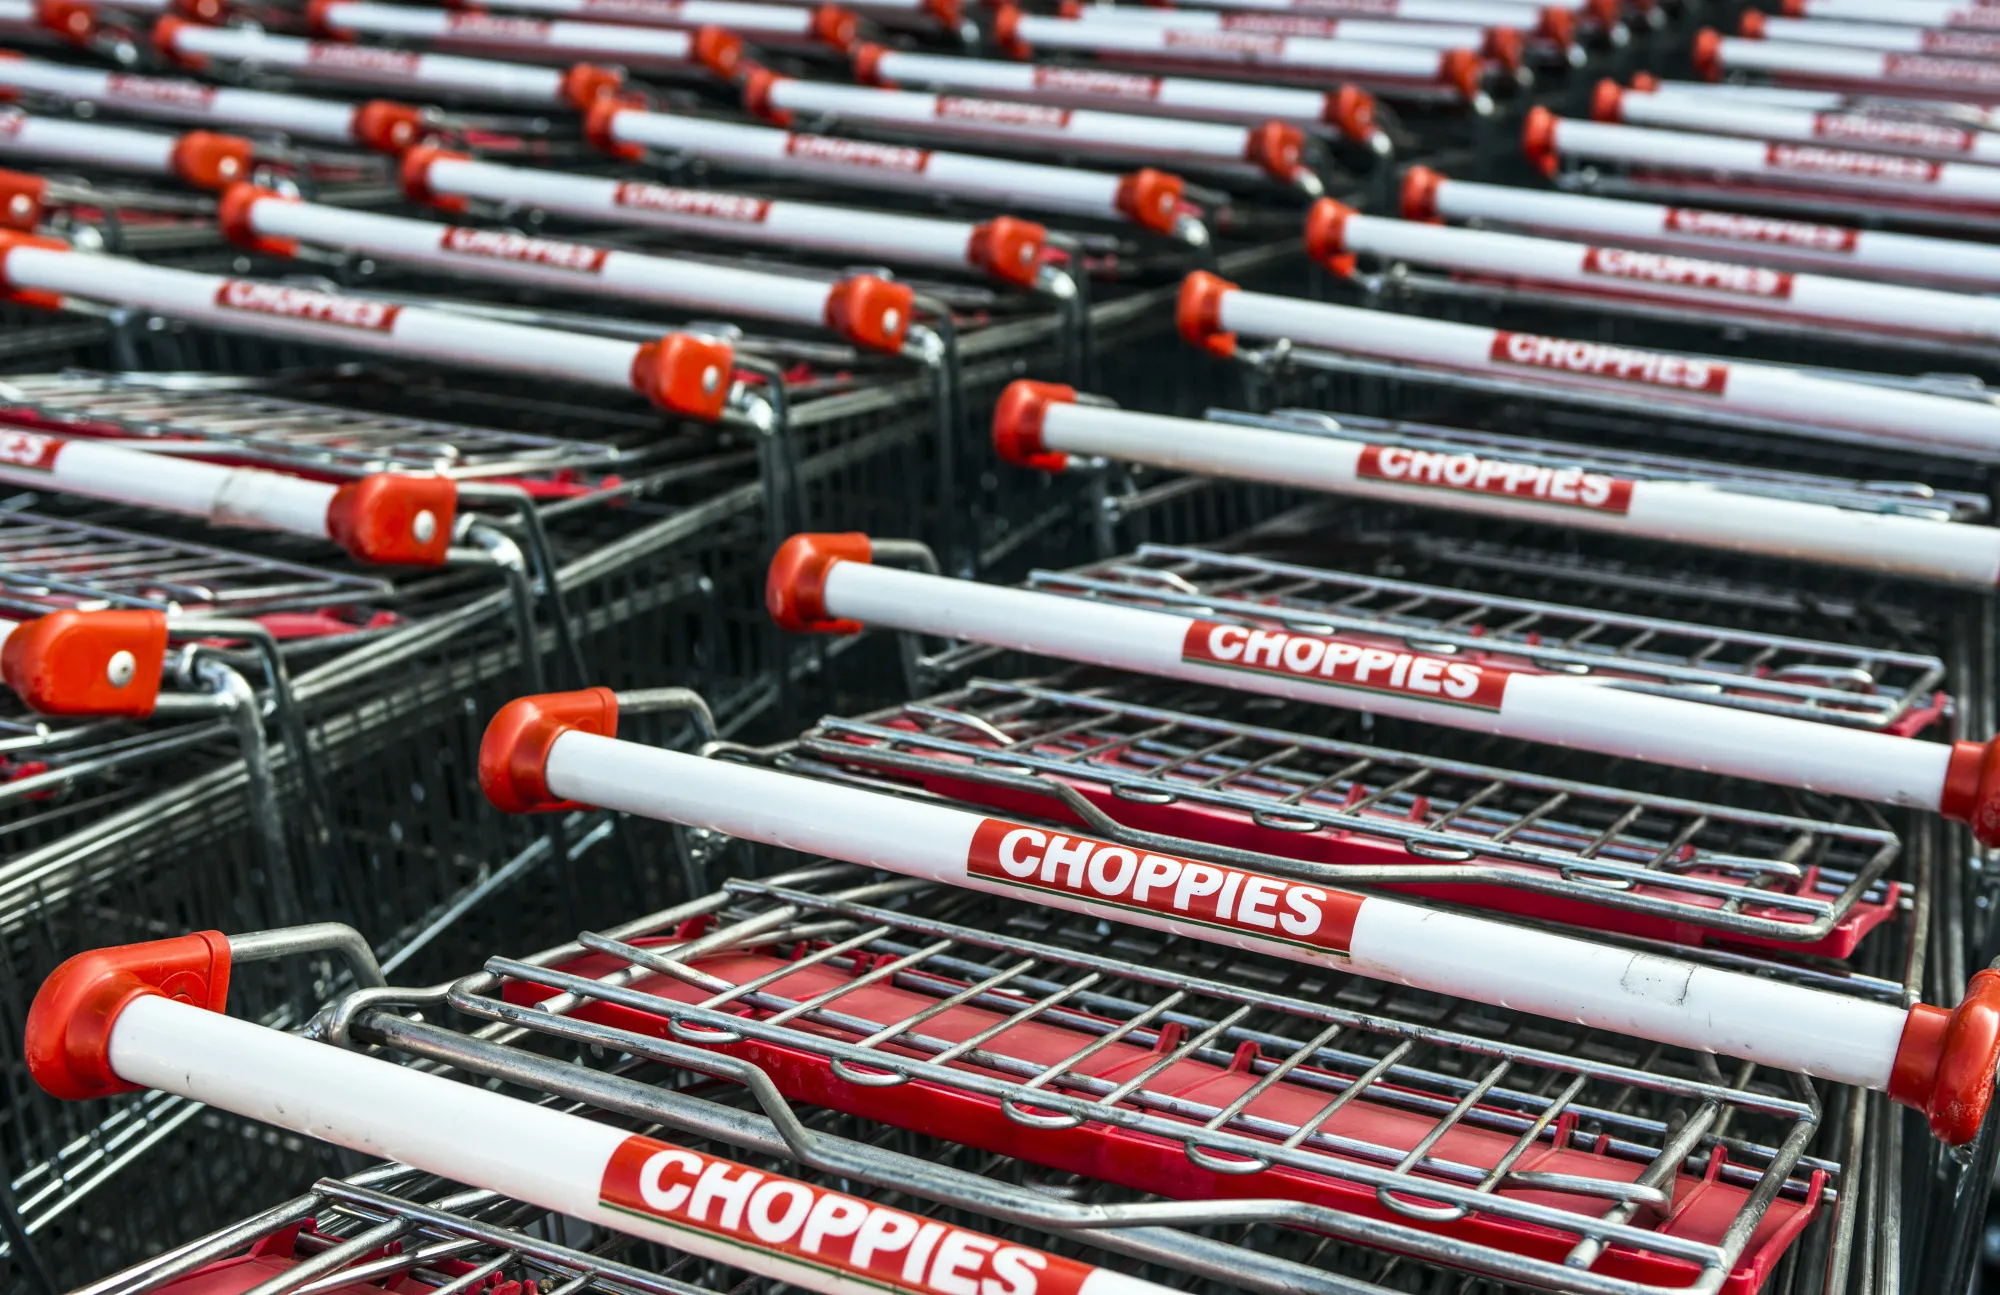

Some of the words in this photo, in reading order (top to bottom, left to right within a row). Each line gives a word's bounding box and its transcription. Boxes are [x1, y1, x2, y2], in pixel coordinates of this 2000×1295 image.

[1507, 332, 1711, 387] CHOPPIES
[1377, 447, 1611, 505] CHOPPIES
[1208, 624, 1483, 698] CHOPPIES
[998, 828, 1328, 937] CHOPPIES
[639, 1150, 1044, 1295] CHOPPIES
